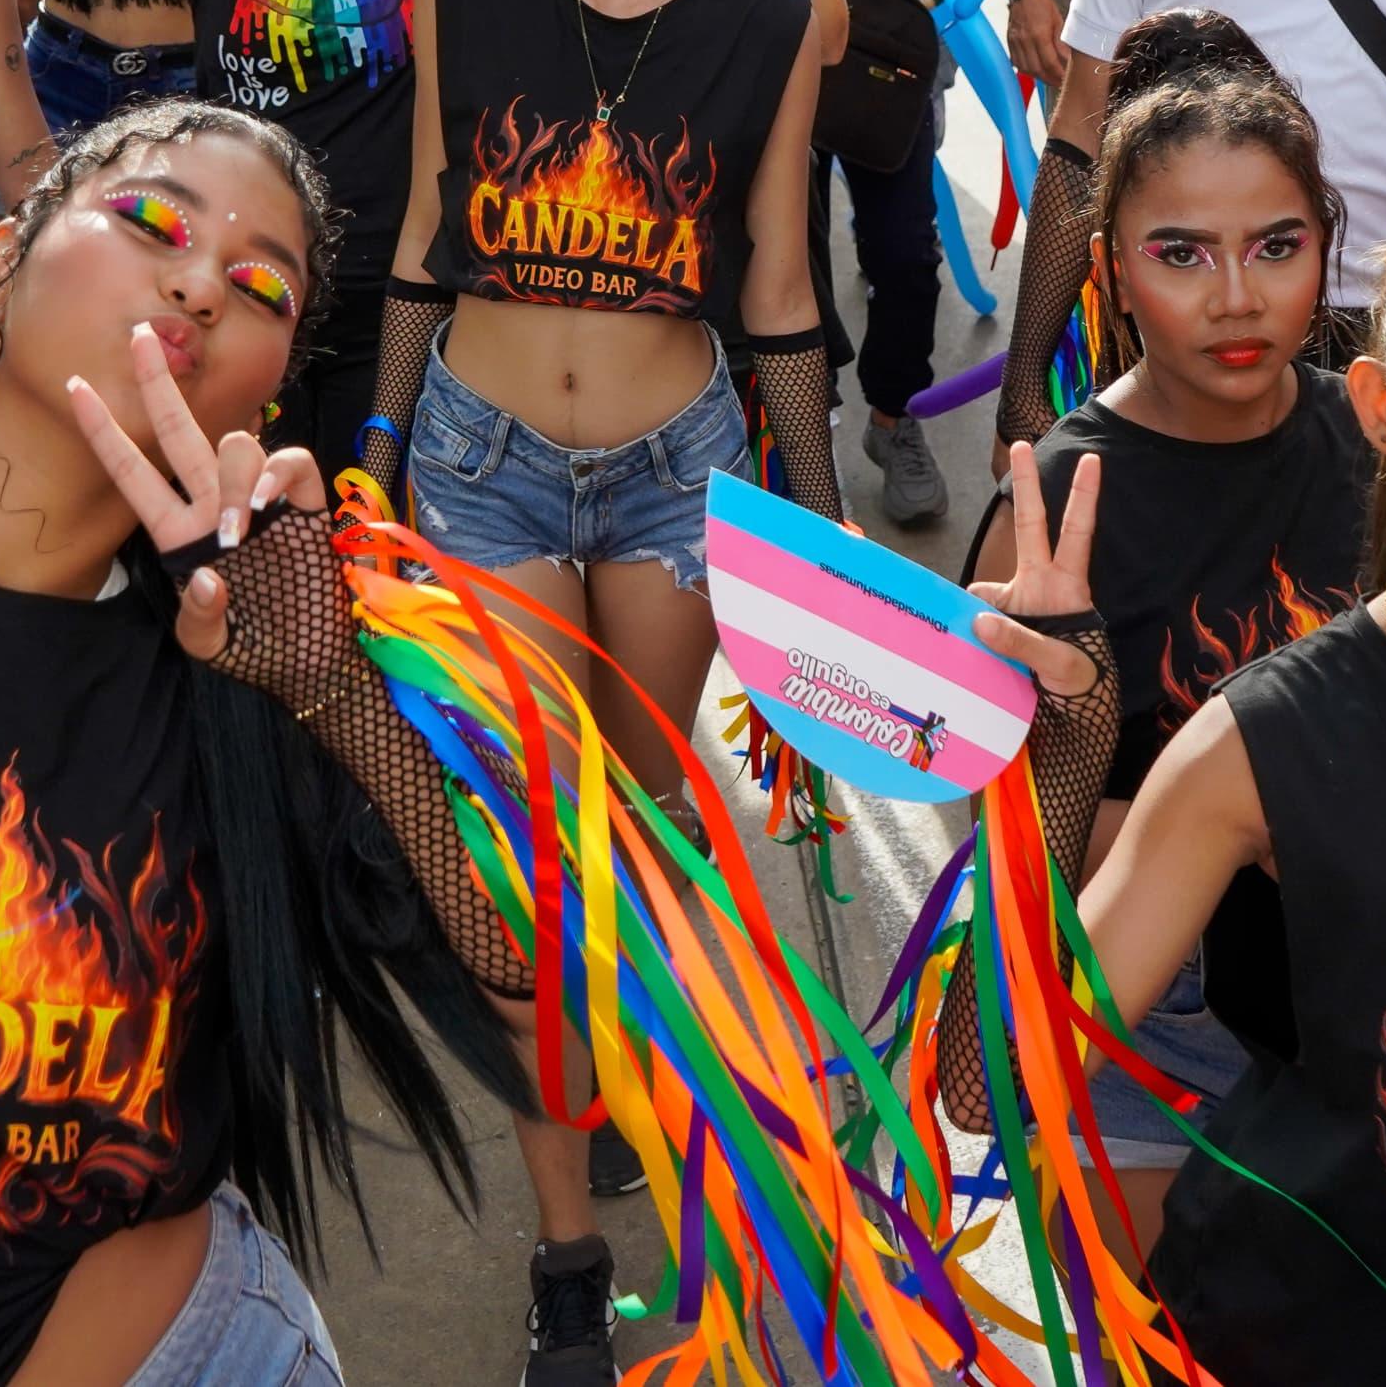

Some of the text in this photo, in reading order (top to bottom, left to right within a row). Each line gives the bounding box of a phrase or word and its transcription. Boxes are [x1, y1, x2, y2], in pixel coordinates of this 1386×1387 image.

[218, 34, 278, 73] love
[227, 73, 290, 110] love
[241, 71, 264, 89] is
[469, 182, 702, 294] CANDELA
[514, 262, 637, 297] VIDEO BAR
[819, 561, 949, 634] #DiversidadesHumanas
[787, 647, 892, 711] es orgullo
[779, 674, 914, 759] Colombia
[7, 1120, 81, 1165] BAR
